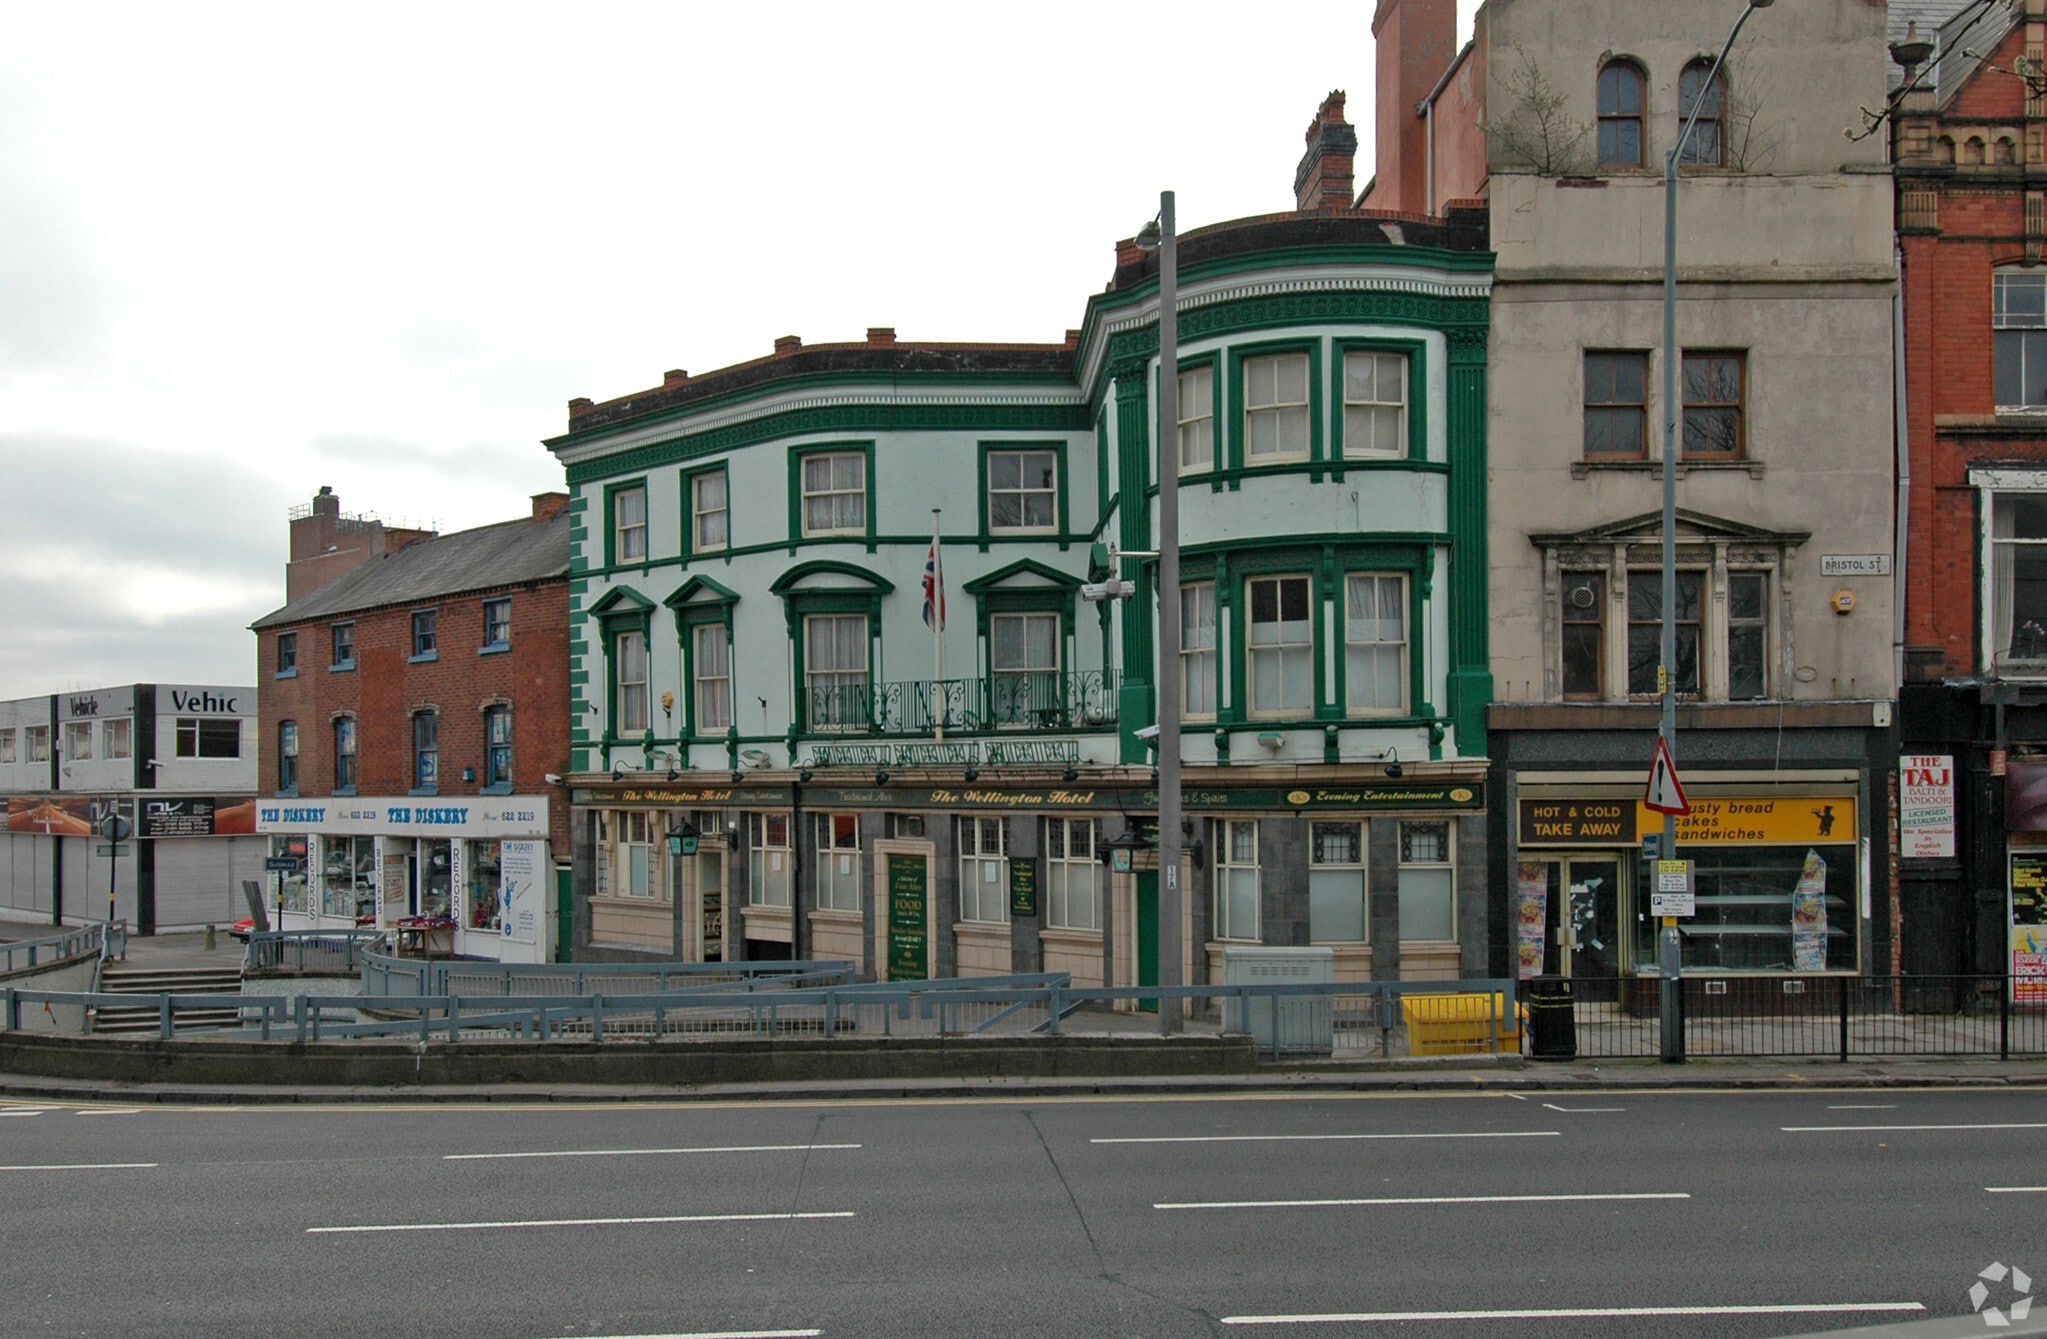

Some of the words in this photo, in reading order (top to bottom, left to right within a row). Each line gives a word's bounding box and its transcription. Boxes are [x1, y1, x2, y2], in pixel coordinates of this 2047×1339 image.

[1825, 561, 1865, 570] BRISTOL
[1869, 560, 1882, 570] ST
[172, 690, 238, 713] Vehic
[1911, 757, 1941, 767] THE
[1902, 768, 1950, 787] TAJ
[622, 790, 641, 801] The
[645, 790, 697, 803] Wellington
[700, 790, 732, 801] Hotel
[1317, 790, 1361, 803] Evening
[1363, 789, 1445, 801] Entertainment
[1909, 788, 1935, 796] BALTI
[1938, 788, 1947, 796] &
[930, 790, 960, 803] The
[963, 791, 1042, 806] Wellington
[1047, 791, 1095, 803] Hotel
[1903, 797, 1952, 805] TANDOORI
[1534, 807, 1560, 817] HOT
[1568, 807, 1578, 817] &
[1584, 807, 1620, 817] COLD
[1689, 802, 1721, 815] usty
[1728, 802, 1774, 813] bread
[1908, 808, 1946, 818] LICENSED
[261, 808, 280, 822] THE
[283, 808, 326, 822] DISKERY
[350, 811, 361, 820] 622
[363, 811, 376, 820] 2219
[388, 808, 410, 823] THE
[415, 808, 468, 824] DISKERY
[501, 812, 514, 821] 622
[517, 812, 535, 821] 2219
[1903, 816, 1952, 826] RESTAURANT
[1533, 823, 1572, 836] TAKE
[1580, 823, 1621, 836] AWAY
[1168, 866, 1176, 888] 17A
[895, 900, 922, 910] FOOD
